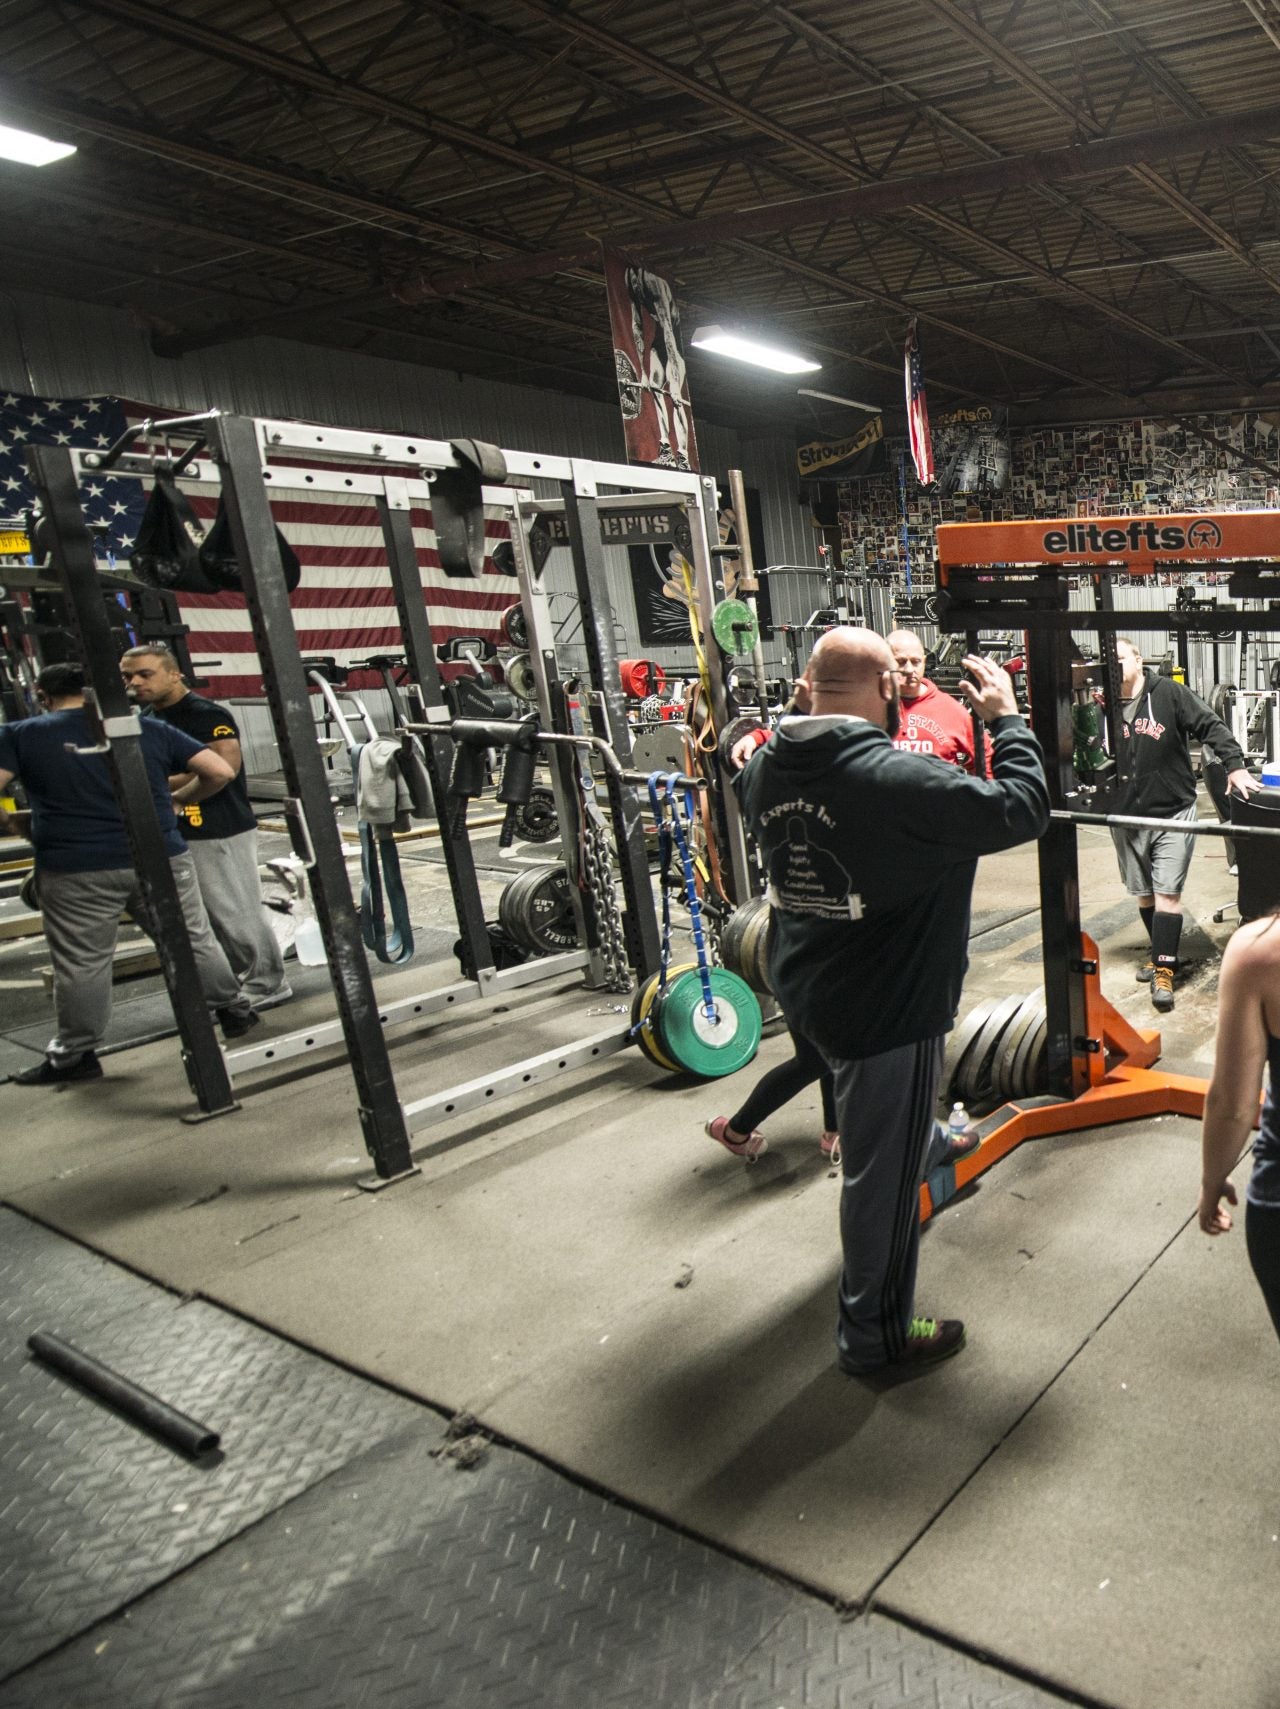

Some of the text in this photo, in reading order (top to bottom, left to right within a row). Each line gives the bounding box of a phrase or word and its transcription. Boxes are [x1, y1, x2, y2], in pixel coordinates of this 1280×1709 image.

[1043, 521, 1186, 553] elitefts
[908, 714, 949, 745] STATE
[760, 798, 814, 827] Experts
